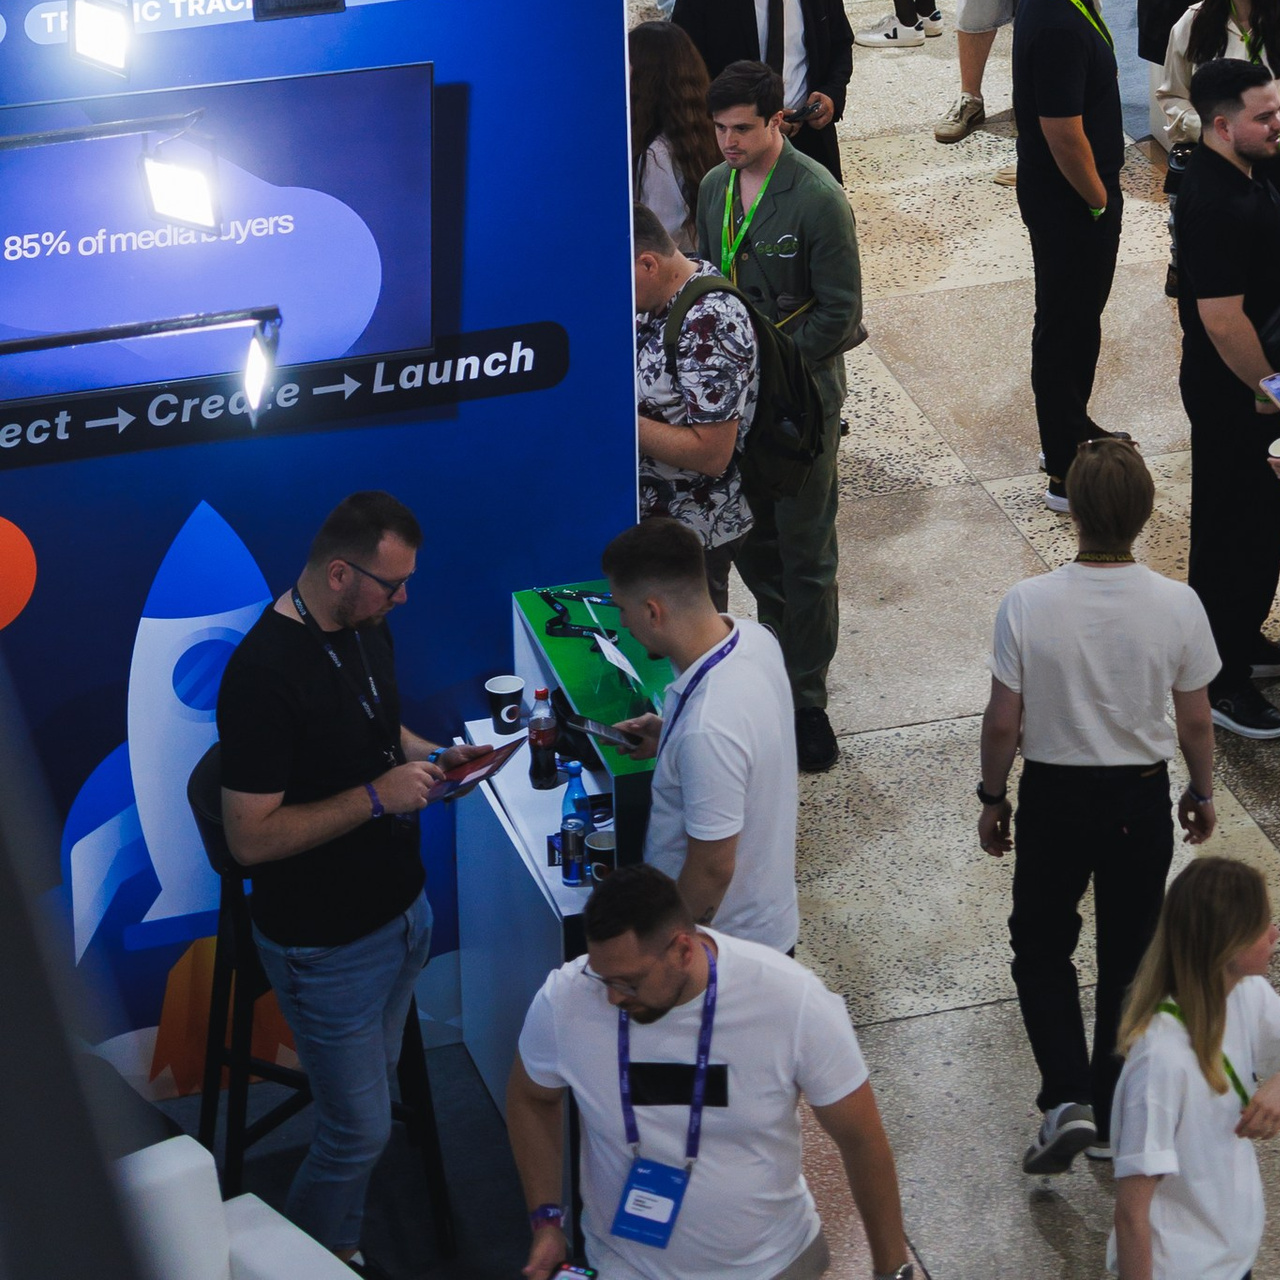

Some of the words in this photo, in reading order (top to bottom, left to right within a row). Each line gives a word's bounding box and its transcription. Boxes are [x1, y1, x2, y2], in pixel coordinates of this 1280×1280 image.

[4, 230, 72, 262] 85%
[77, 227, 109, 258] of
[110, 221, 198, 253] media
[146, 378, 300, 429] Creae
[372, 341, 536, 396] Launch
